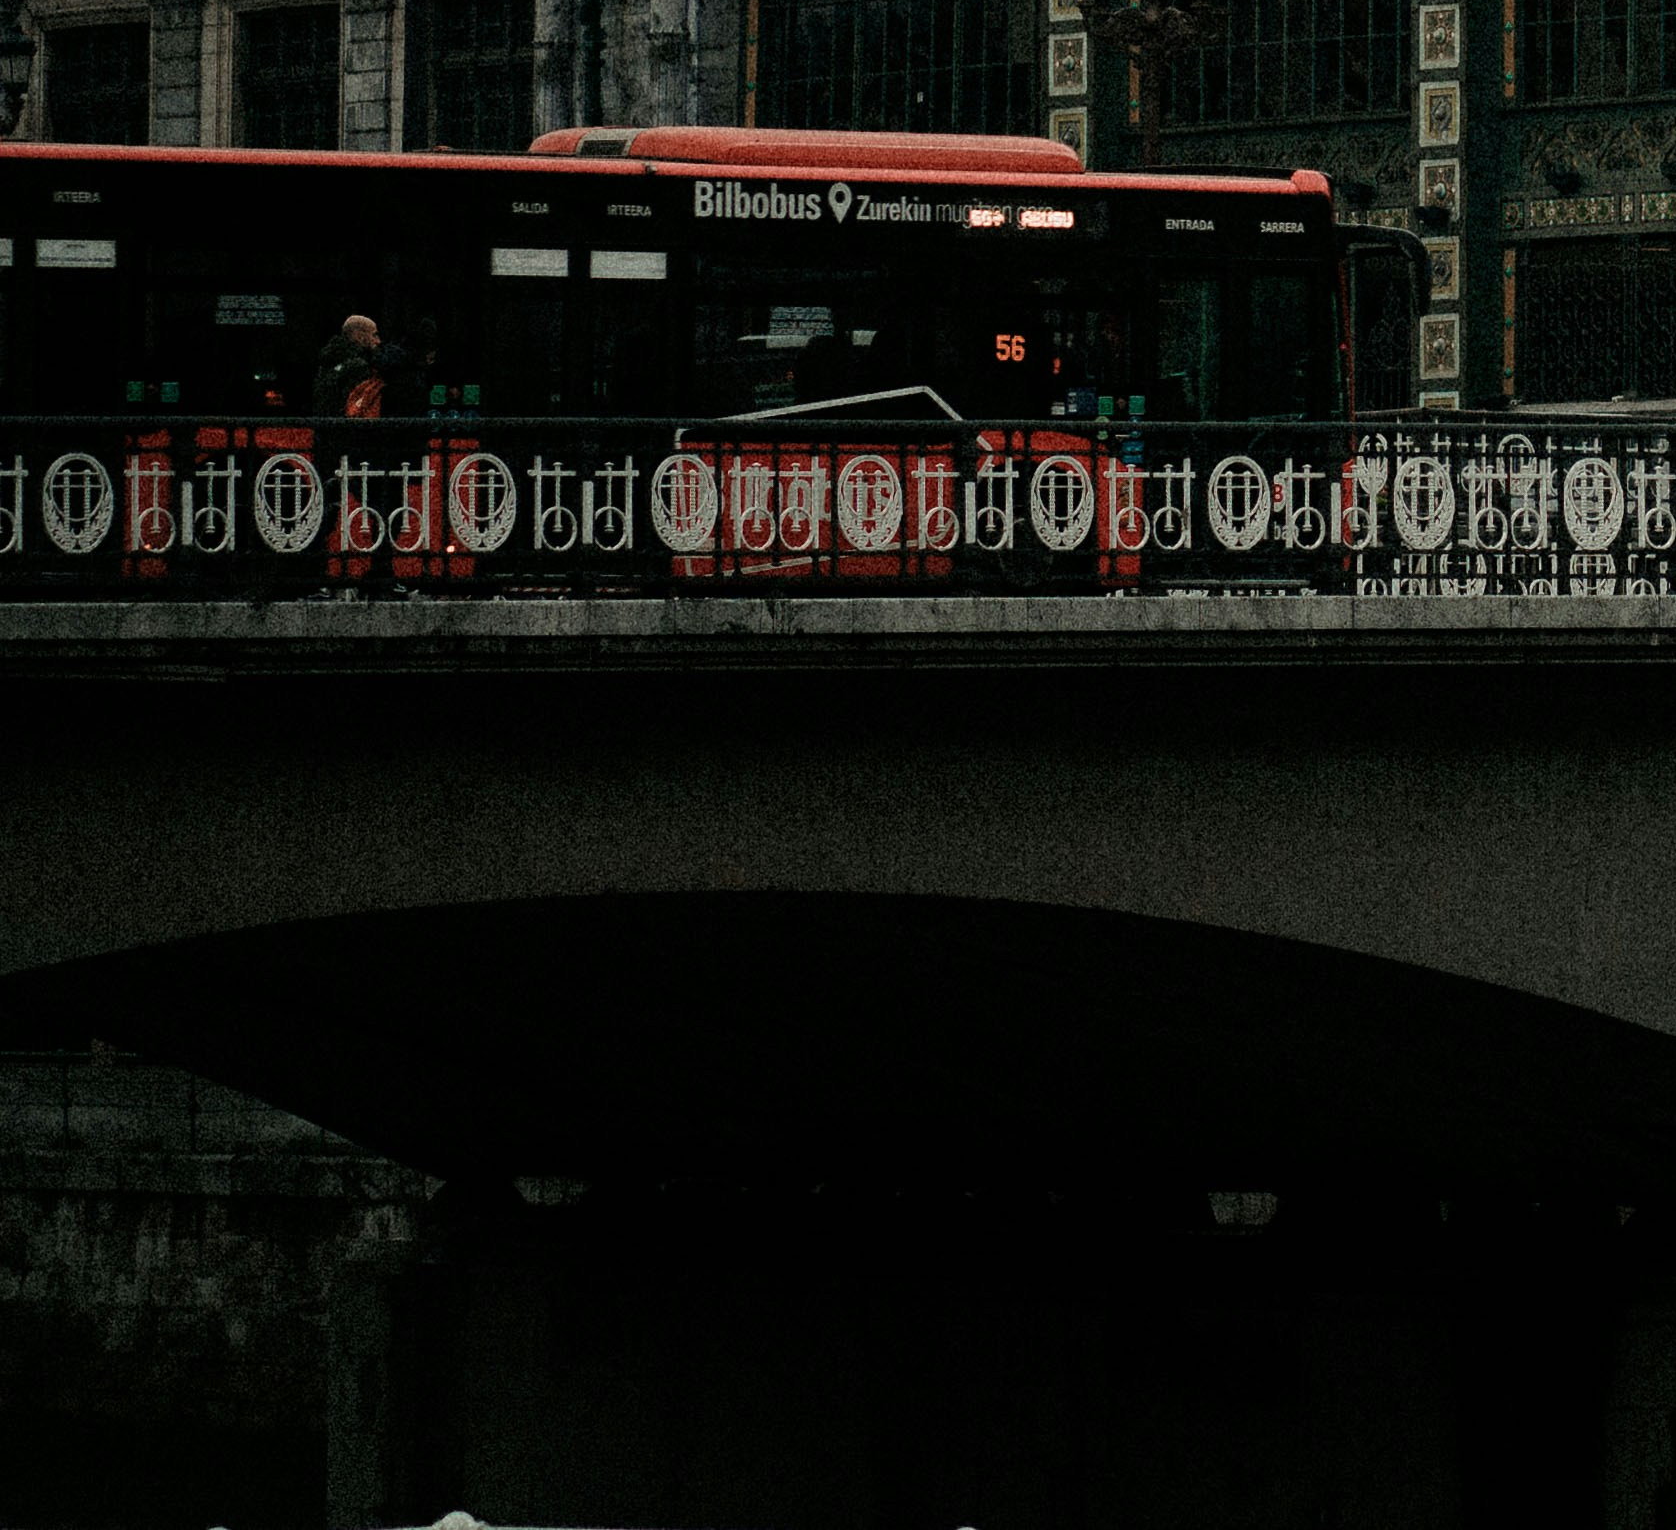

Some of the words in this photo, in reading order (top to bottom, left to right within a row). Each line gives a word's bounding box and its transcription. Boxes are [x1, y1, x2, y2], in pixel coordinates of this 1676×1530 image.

[511, 201, 550, 215] SALIDA
[693, 180, 822, 221] Bilbobus
[856, 194, 932, 224] Zurekin
[607, 204, 652, 218] IRTEERA
[1165, 218, 1214, 232] ENTRADA
[1260, 221, 1305, 234] SARRERA
[994, 333, 1026, 363] 56
